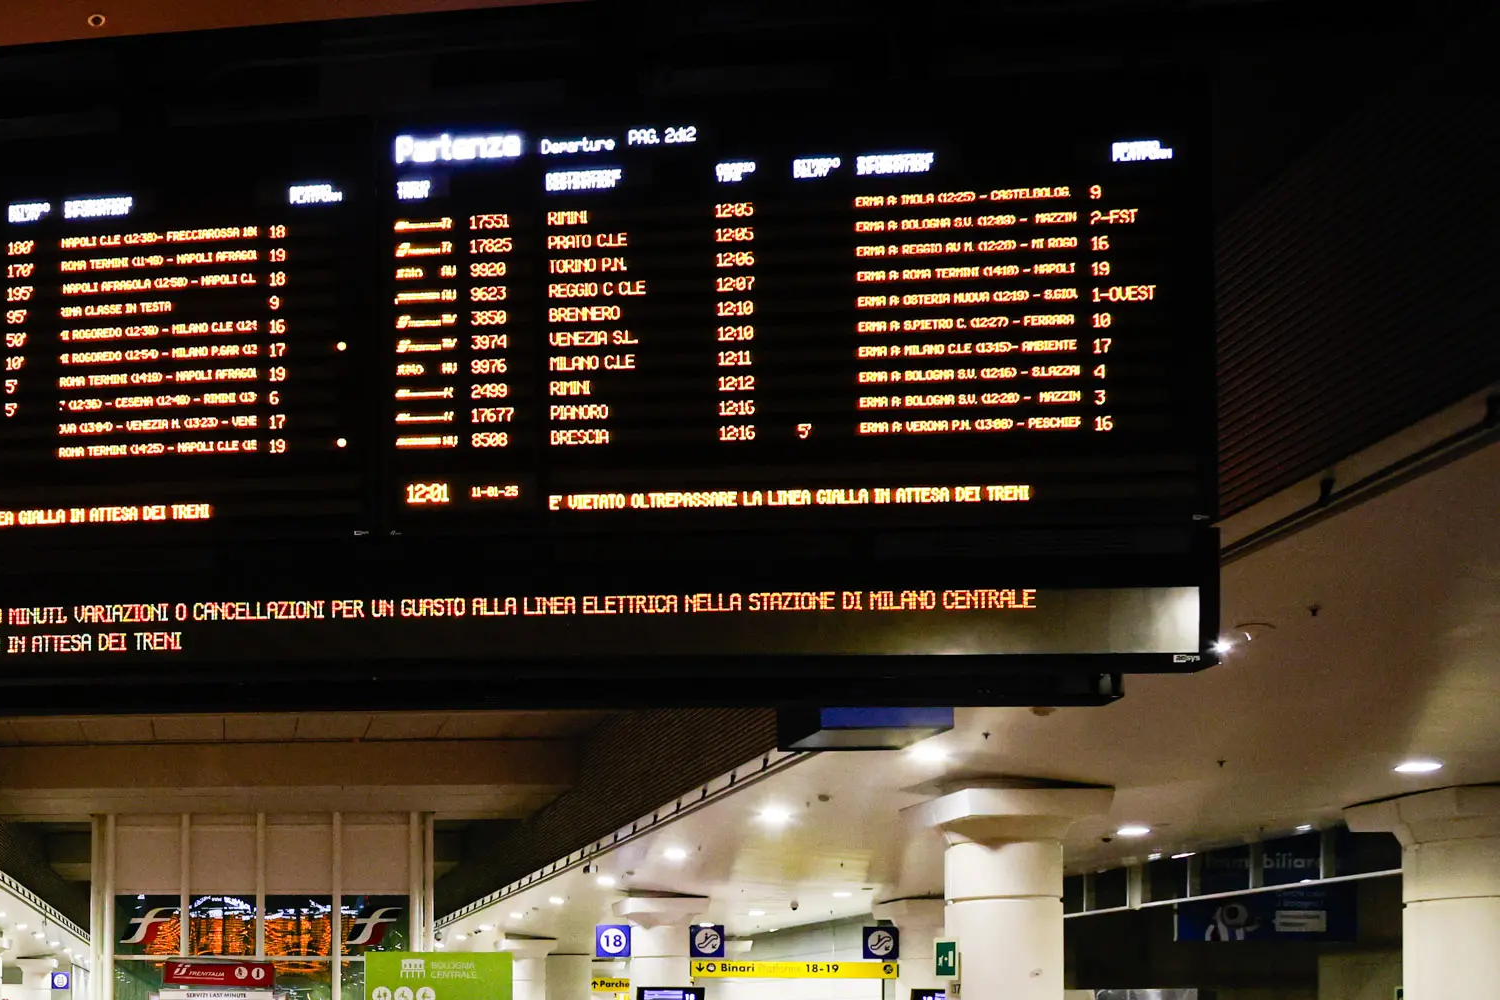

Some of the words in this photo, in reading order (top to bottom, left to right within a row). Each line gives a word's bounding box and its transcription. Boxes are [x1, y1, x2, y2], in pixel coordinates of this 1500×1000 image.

[470, 214, 509, 229] 17551
[548, 211, 587, 225] RIMINI
[715, 203, 753, 218] 12:05
[1090, 185, 1101, 199] 9
[270, 225, 286, 238] 18
[470, 262, 506, 277] 9920
[550, 258, 596, 273] TORINO
[716, 252, 754, 267] 12:06
[1091, 236, 1109, 250] 16
[471, 310, 506, 325] 3850
[549, 306, 620, 322] BRENNERO
[717, 301, 753, 316] 12:10
[270, 343, 285, 357] 17
[269, 391, 279, 405] 6
[472, 432, 508, 447] 8508
[551, 429, 609, 445] BRESCIA
[1095, 416, 1113, 431] 16
[407, 483, 449, 504] 12:01
[75, 603, 168, 623] VARIAZIONI
[176, 603, 188, 621] O
[193, 601, 325, 620] CANCELLAZIONI
[332, 600, 364, 618] PER
[372, 600, 394, 617] UN
[401, 598, 465, 617] GUASTO
[472, 598, 517, 615] ALLA
[524, 597, 576, 615] LINEA
[583, 595, 677, 614] ELETTRICA
[685, 593, 741, 612] NELLA
[748, 592, 835, 610] STAZIONE
[843, 592, 862, 610] DI
[870, 591, 935, 610] MILANO
[942, 589, 1036, 609] CENTRALE
[8, 636, 25, 653] IN
[32, 634, 91, 652] ATTESA
[99, 633, 127, 651] DEI
[134, 632, 181, 650] TRENI
[604, 935, 622, 948] 18
[430, 961, 476, 970] BOLOGNA
[720, 964, 754, 972] Binari
[805, 964, 839, 973] 18-19
[430, 970, 478, 979] CENTRALE
